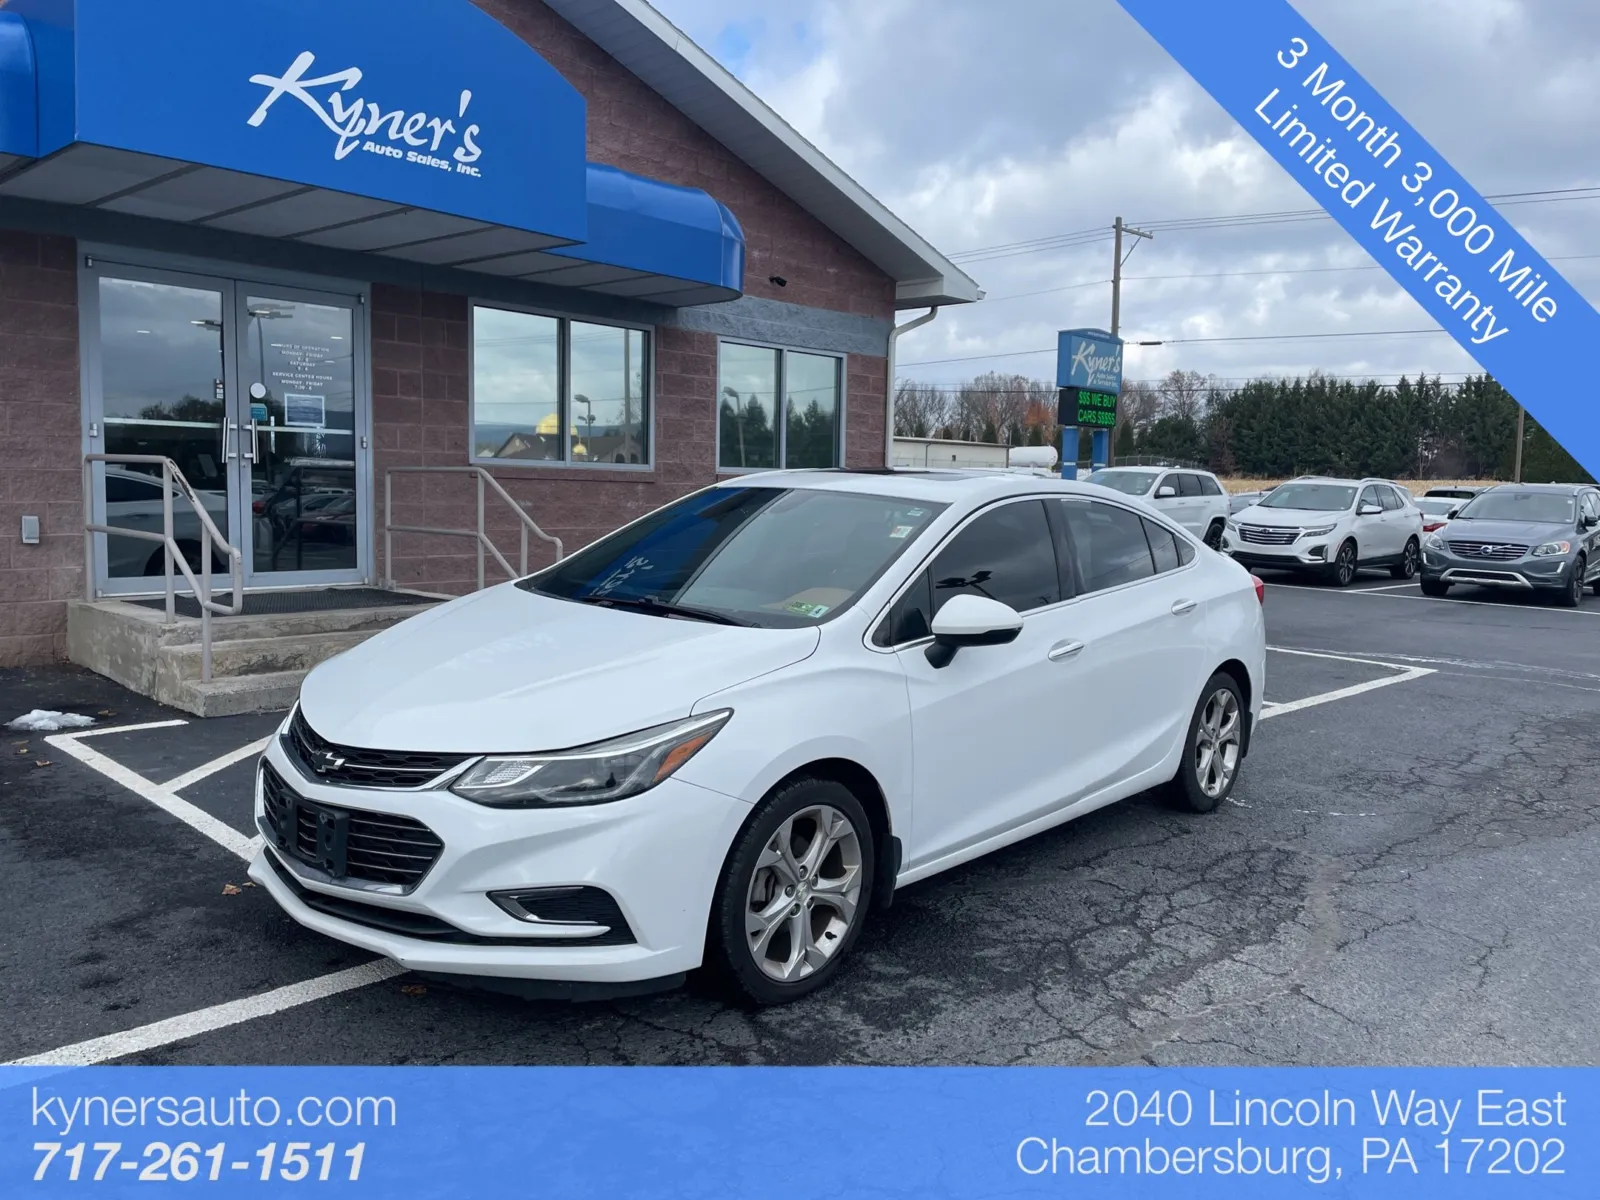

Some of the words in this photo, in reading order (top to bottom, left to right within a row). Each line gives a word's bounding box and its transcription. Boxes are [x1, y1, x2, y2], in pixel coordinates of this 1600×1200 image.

[247, 50, 482, 161] Kyner's
[362, 140, 403, 159] Auto
[406, 151, 452, 172] Sales,
[456, 162, 482, 177] Inc.
[1071, 340, 1121, 388] Kyner's
[1078, 409, 1097, 423] CARS
[1091, 392, 1103, 406] WE
[1103, 394, 1117, 408] BUY
